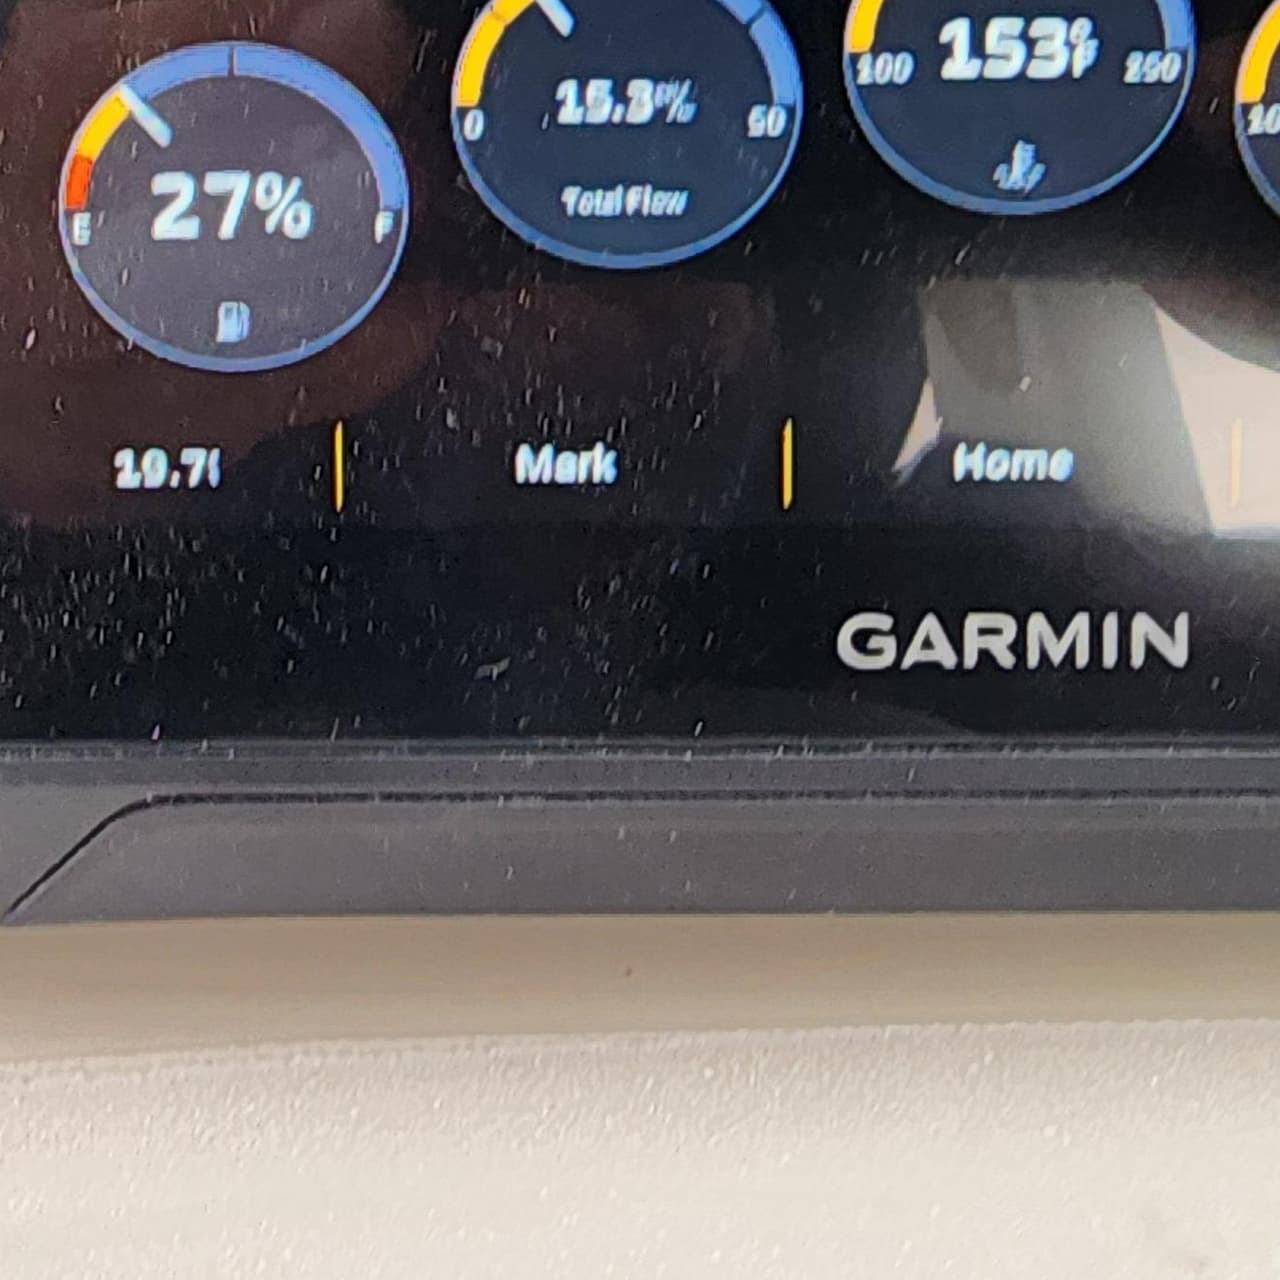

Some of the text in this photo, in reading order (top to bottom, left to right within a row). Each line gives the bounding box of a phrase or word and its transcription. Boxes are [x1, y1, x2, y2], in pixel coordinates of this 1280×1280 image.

[856, 52, 914, 84] 100
[462, 109, 484, 139] 0
[151, 171, 313, 241] 27%
[561, 183, 689, 217] Total Flow
[73, 212, 91, 244] E
[374, 212, 394, 243] F
[515, 444, 616, 486] Mark
[952, 441, 1073, 484] Home
[835, 611, 1190, 671] GARMIN
